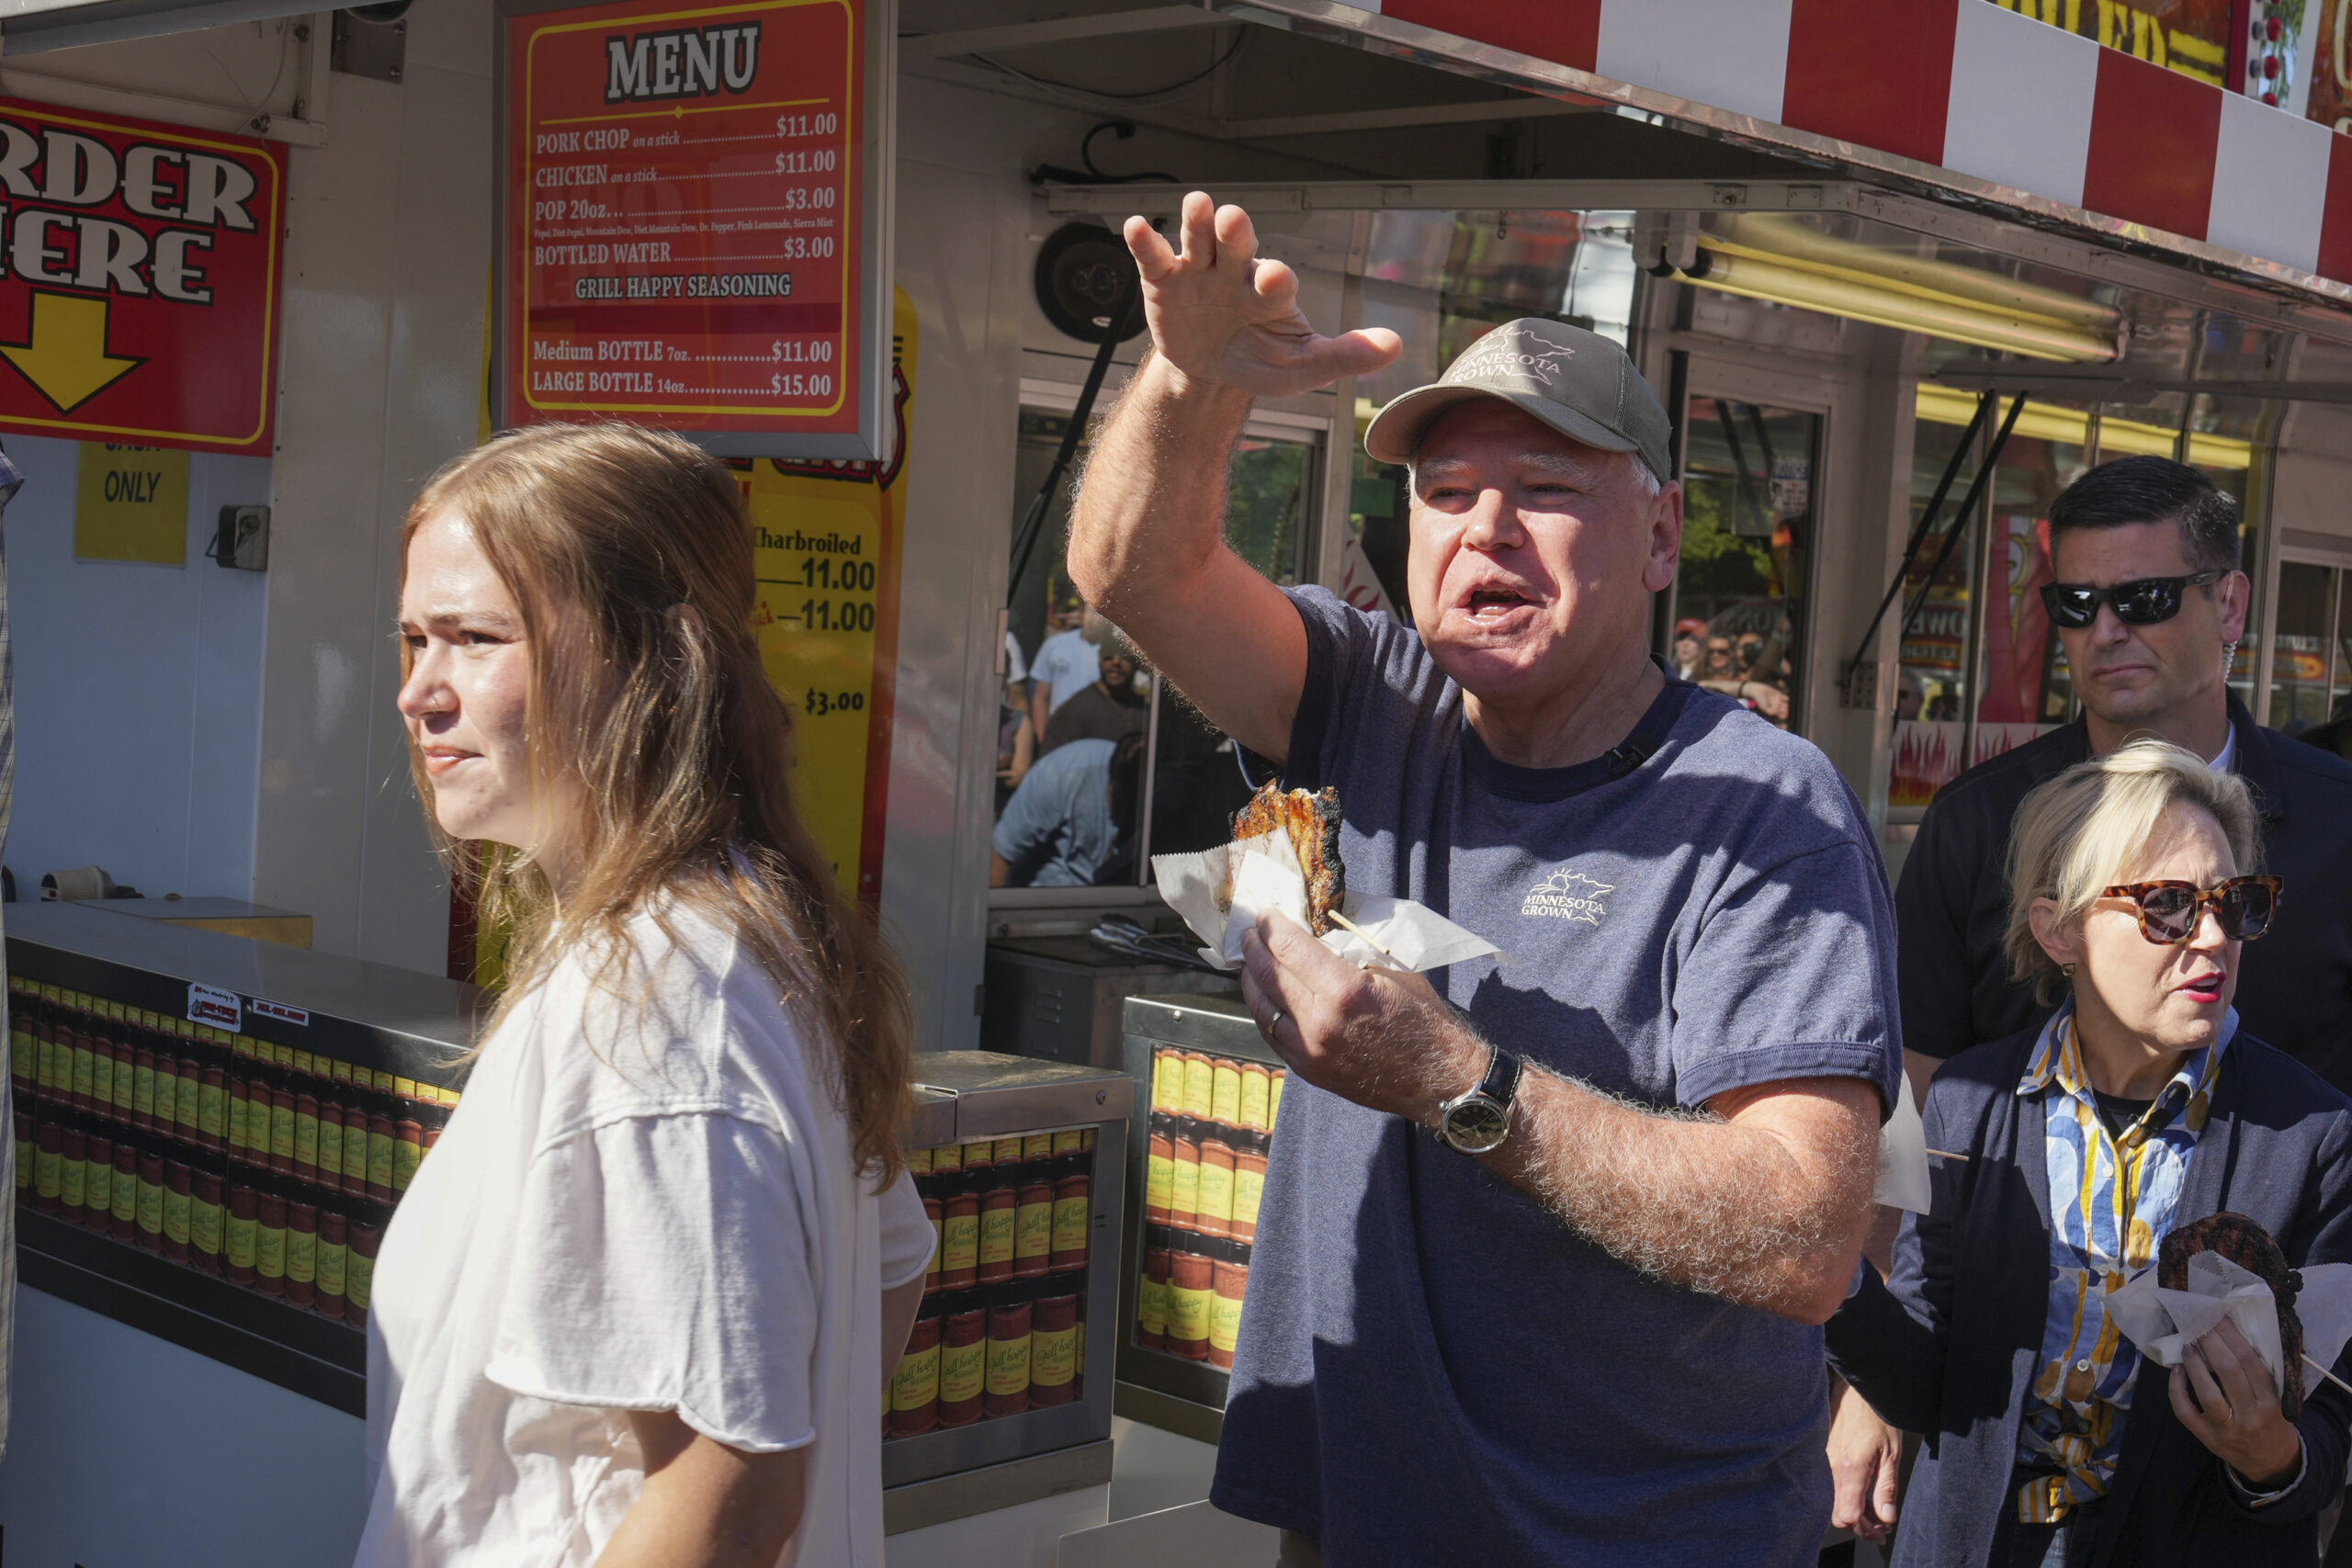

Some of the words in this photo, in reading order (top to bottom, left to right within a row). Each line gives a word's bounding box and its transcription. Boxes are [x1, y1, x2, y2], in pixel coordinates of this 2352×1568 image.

[605, 23, 761, 102] MENU
[536, 132, 581, 154] PORK
[583, 129, 630, 151] CHOP
[632, 136, 646, 148] on
[647, 135, 654, 147] a
[654, 130, 680, 146] stick
[776, 113, 837, 140] $11.00
[536, 164, 608, 187] CHICKEN
[610, 172, 624, 183] on
[625, 172, 631, 182] a
[632, 167, 658, 182] stick
[775, 150, 836, 176] $11.00
[536, 199, 567, 220] POP
[786, 186, 836, 211] $3.00
[585, 226, 616, 237] Mountain
[649, 223, 681, 234] Mountain
[699, 222, 709, 231] Dr.
[710, 220, 736, 234] Pepper,
[738, 220, 753, 231] Pink
[754, 219, 793, 230] Lemonade,
[794, 218, 815, 229] Sierra
[817, 217, 833, 228] Mist
[0, 205, 214, 304] ERE
[535, 243, 609, 265] BOTTLED
[612, 242, 672, 264] WATER
[785, 236, 834, 261] $3.00
[574, 276, 624, 299] GRILL
[626, 275, 685, 299] HAPPY
[686, 273, 792, 298] SEASONING
[534, 340, 594, 361] Medium
[597, 341, 663, 361] BOTTLE
[772, 339, 832, 364] $11.00
[533, 371, 585, 392] LARGE
[589, 372, 653, 393] BOTTLE
[771, 373, 831, 397] $15.00
[105, 470, 162, 502] ONLY
[801, 558, 876, 592] 11.00
[801, 599, 875, 632] 11.00
[806, 687, 864, 716] $3.00
[1521, 905, 1573, 919] GROWN
[1522, 895, 1606, 915] MINNESOTA
